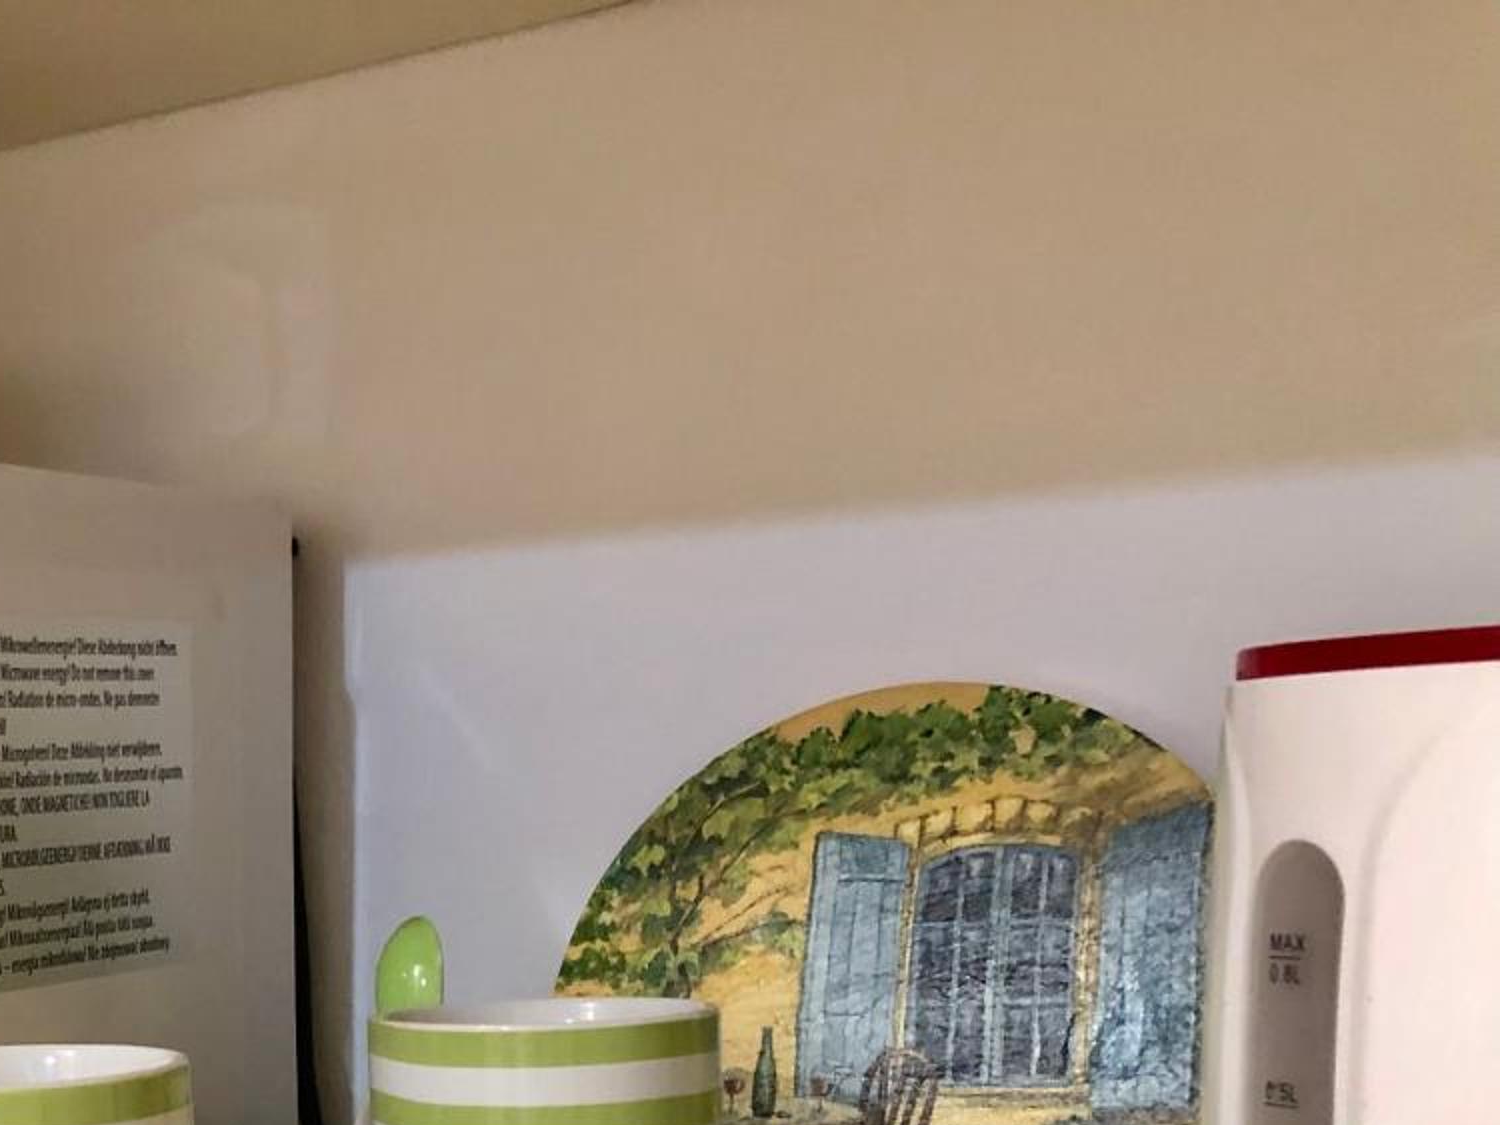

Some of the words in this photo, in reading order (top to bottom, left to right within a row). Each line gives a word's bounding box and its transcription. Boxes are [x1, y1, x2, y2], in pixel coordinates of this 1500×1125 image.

[46, 689, 55, 708] de
[114, 694, 126, 711] pas
[1268, 933, 1306, 952] MAX
